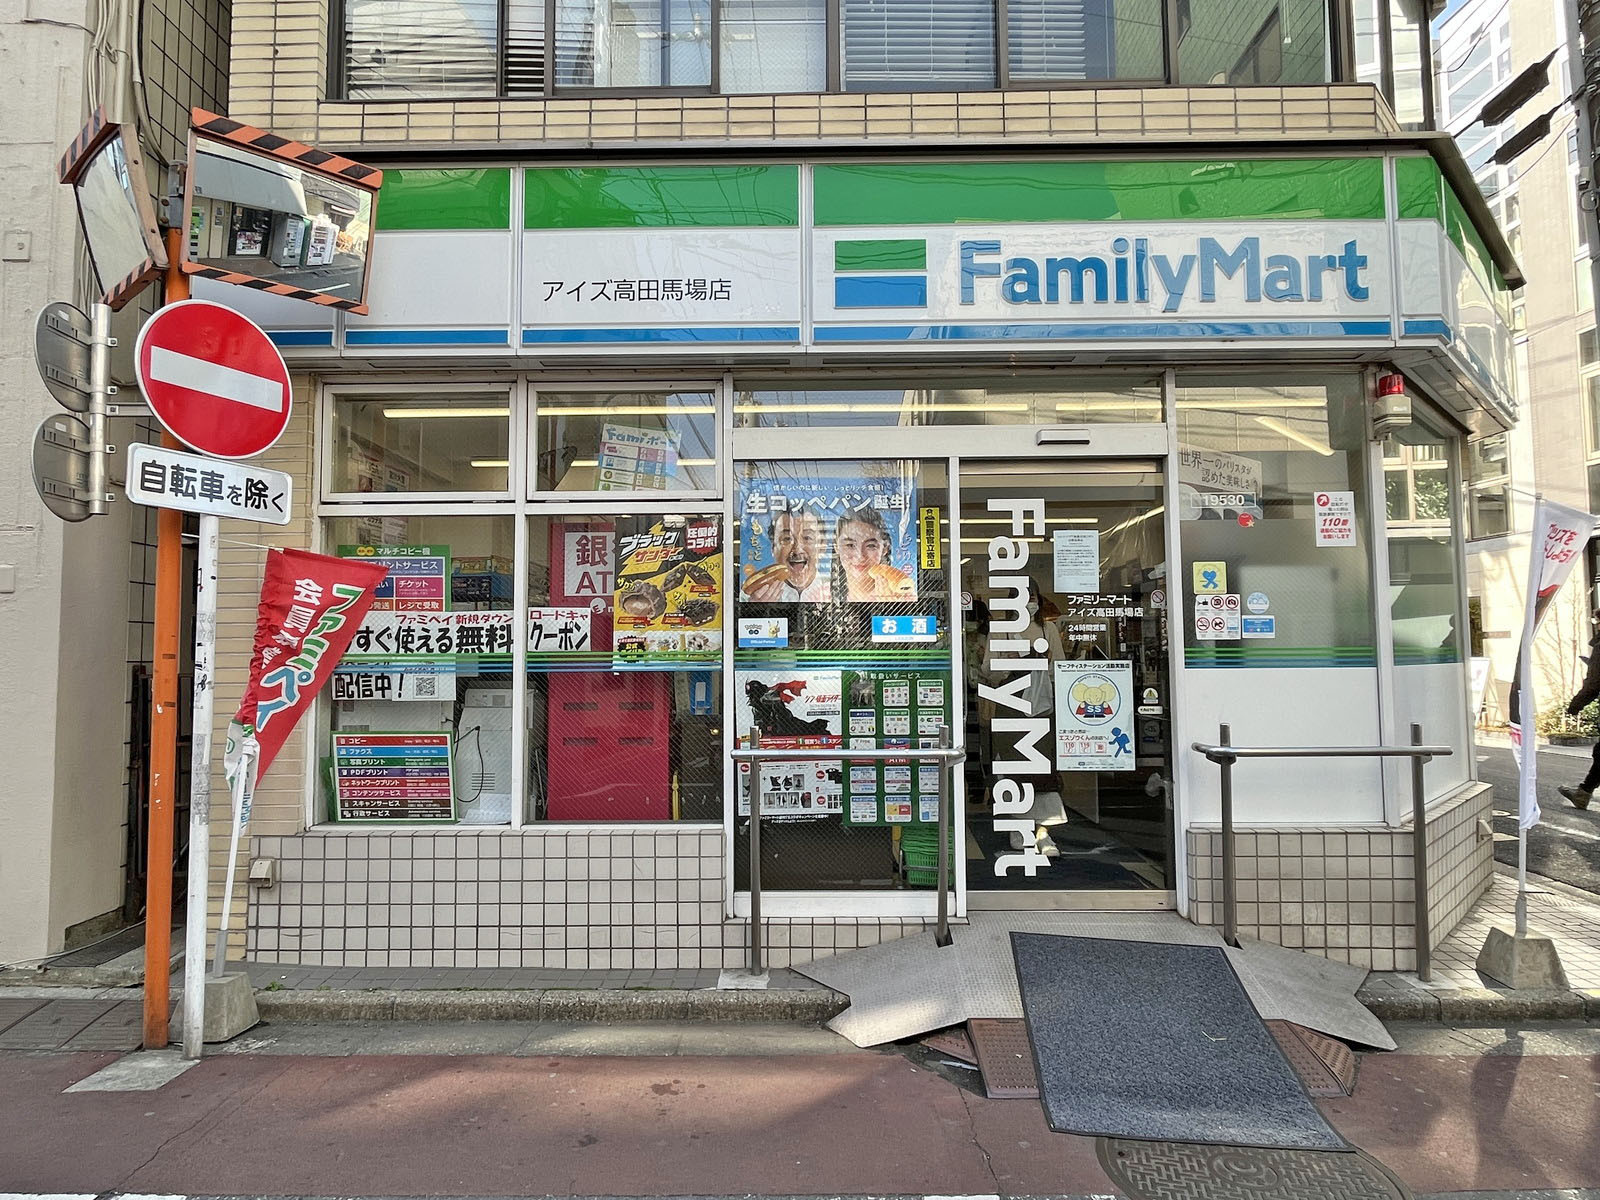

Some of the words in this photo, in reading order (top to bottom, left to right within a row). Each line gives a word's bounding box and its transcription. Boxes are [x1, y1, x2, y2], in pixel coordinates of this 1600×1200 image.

[958, 237, 1370, 313] FamilyMart
[542, 279, 731, 302] アイズ高田馬場店
[141, 460, 284, 513] 自転車を除く
[1203, 494, 1245, 506] 19530
[575, 535, 615, 567] 銀
[619, 531, 680, 558] ブラック
[399, 580, 429, 588] チケット
[575, 572, 614, 593] AT
[1067, 594, 1132, 605] ファミリーマート
[395, 614, 453, 626] ファミペイ
[1067, 607, 1144, 617] アイズ高田馬場店
[530, 621, 589, 651] クーポン
[881, 618, 927, 634] お酒
[346, 624, 514, 653] すぐ使える無料
[978, 498, 1052, 877] FamilyMart
[1087, 705, 1102, 713] SS
